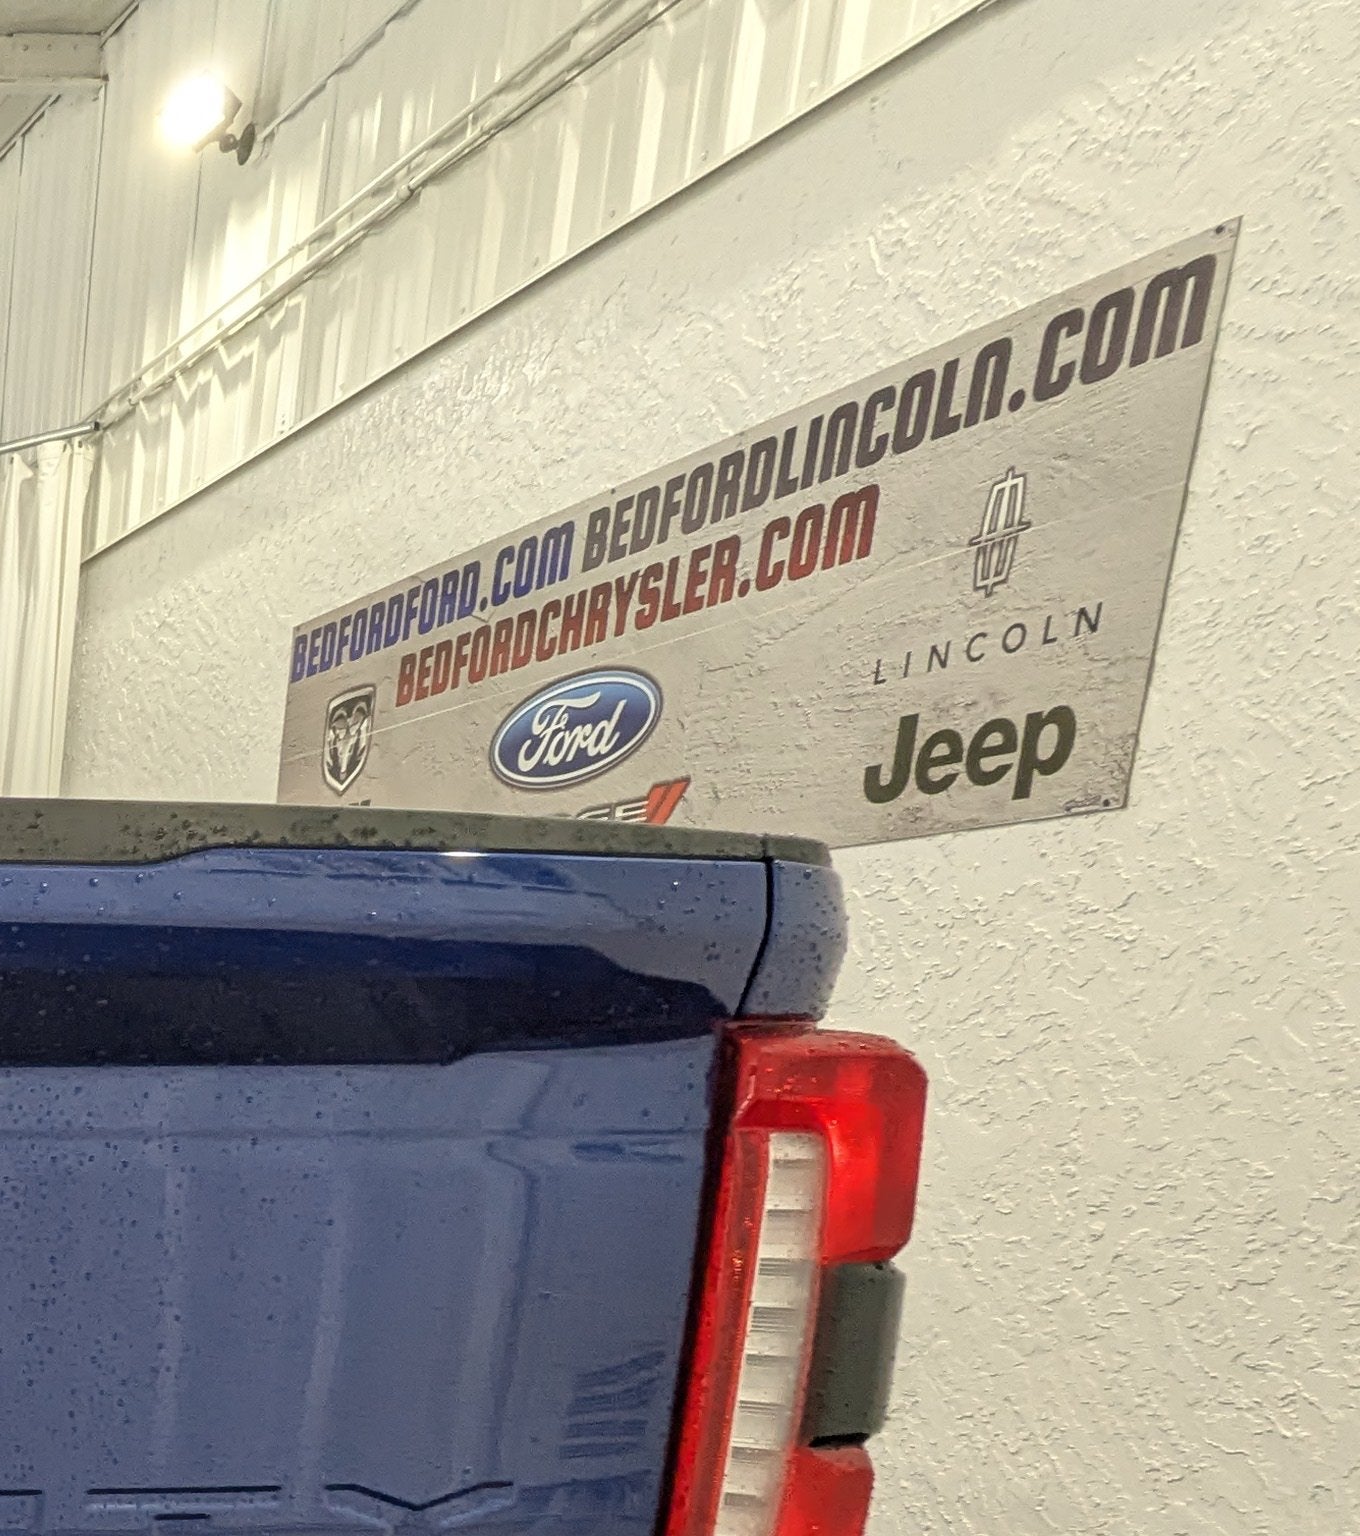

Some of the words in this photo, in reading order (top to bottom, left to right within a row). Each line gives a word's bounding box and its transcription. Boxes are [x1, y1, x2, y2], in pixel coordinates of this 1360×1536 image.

[290, 520, 576, 683] BEDFORDFORD.COM
[581, 252, 1218, 573] BEDFORDLINCOLN.COM
[394, 483, 880, 708] BEDFORDCHRYSLER.COM
[873, 601, 1103, 685] LINCOLN
[517, 691, 628, 773] Ford
[863, 704, 1077, 804] Jeep
